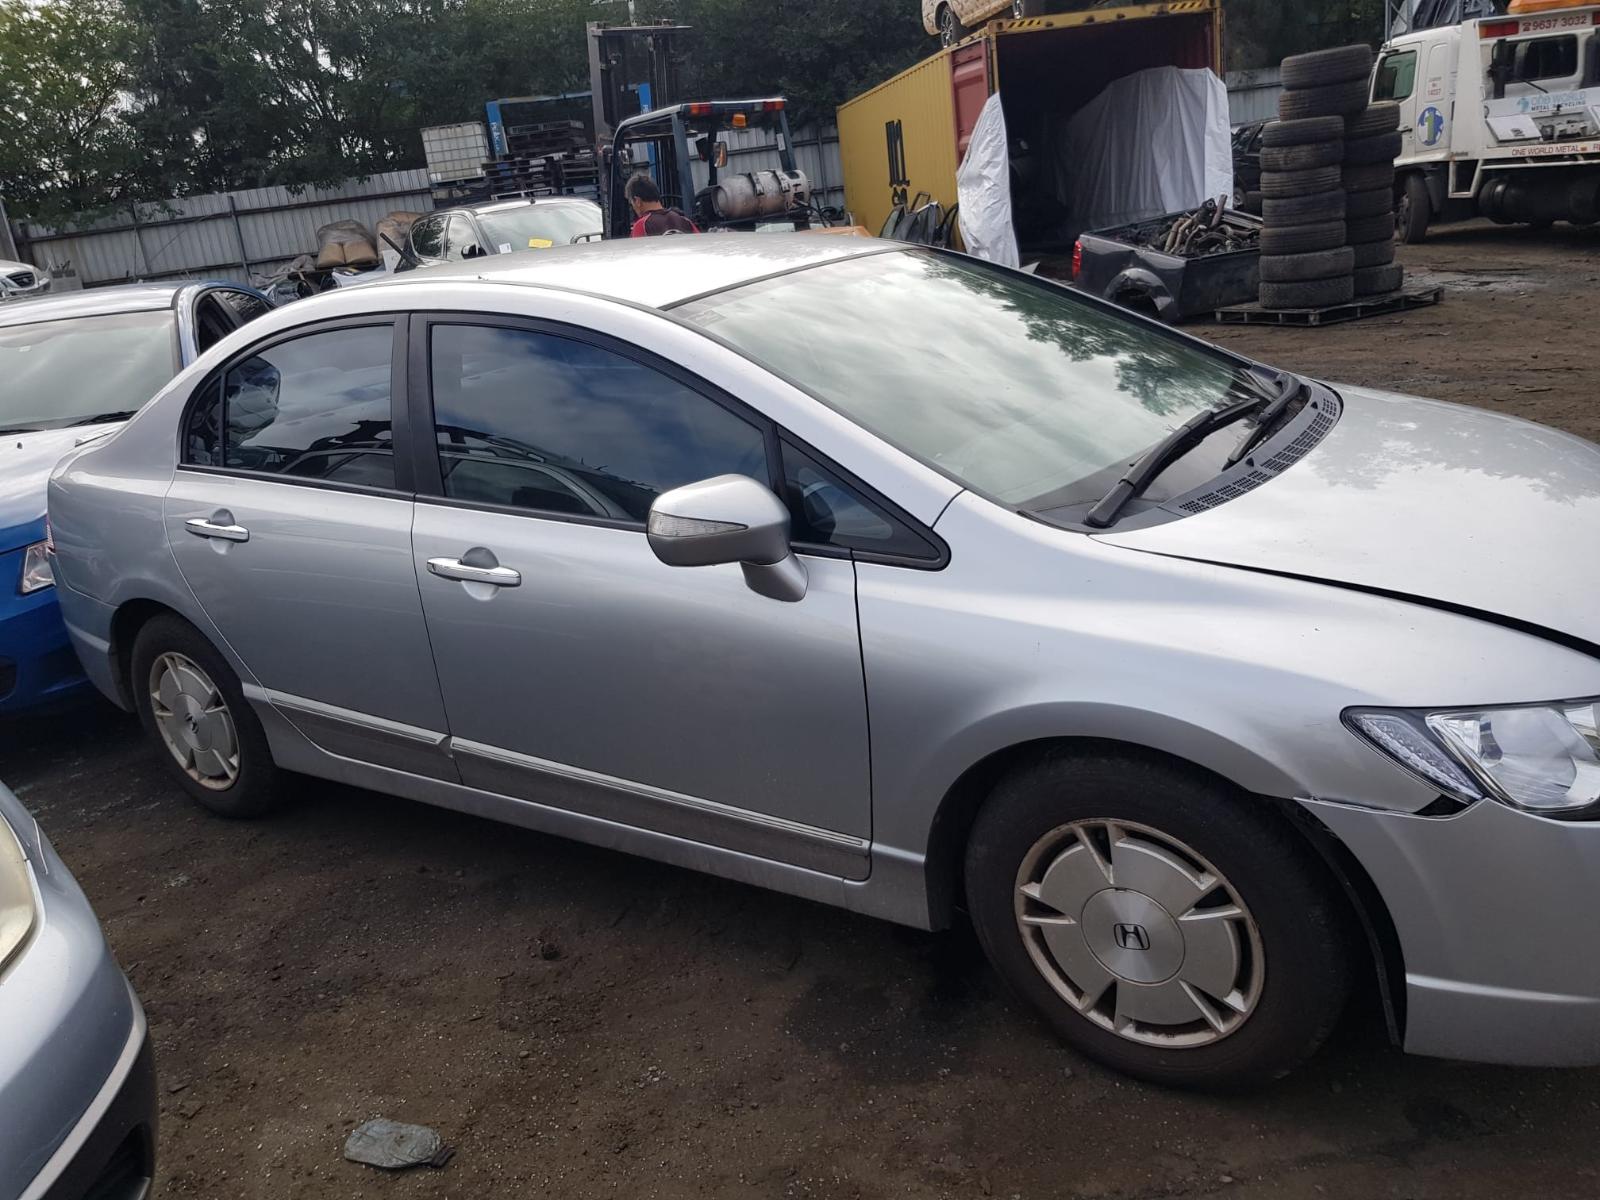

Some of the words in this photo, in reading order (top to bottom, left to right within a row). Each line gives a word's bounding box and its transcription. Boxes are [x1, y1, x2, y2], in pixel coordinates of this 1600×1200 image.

[1532, 19, 1559, 31] 9637
[1560, 15, 1587, 27] 3032
[1511, 148, 1527, 156] ONE
[1527, 146, 1554, 155] WORLD
[1555, 144, 1580, 153] METAL
